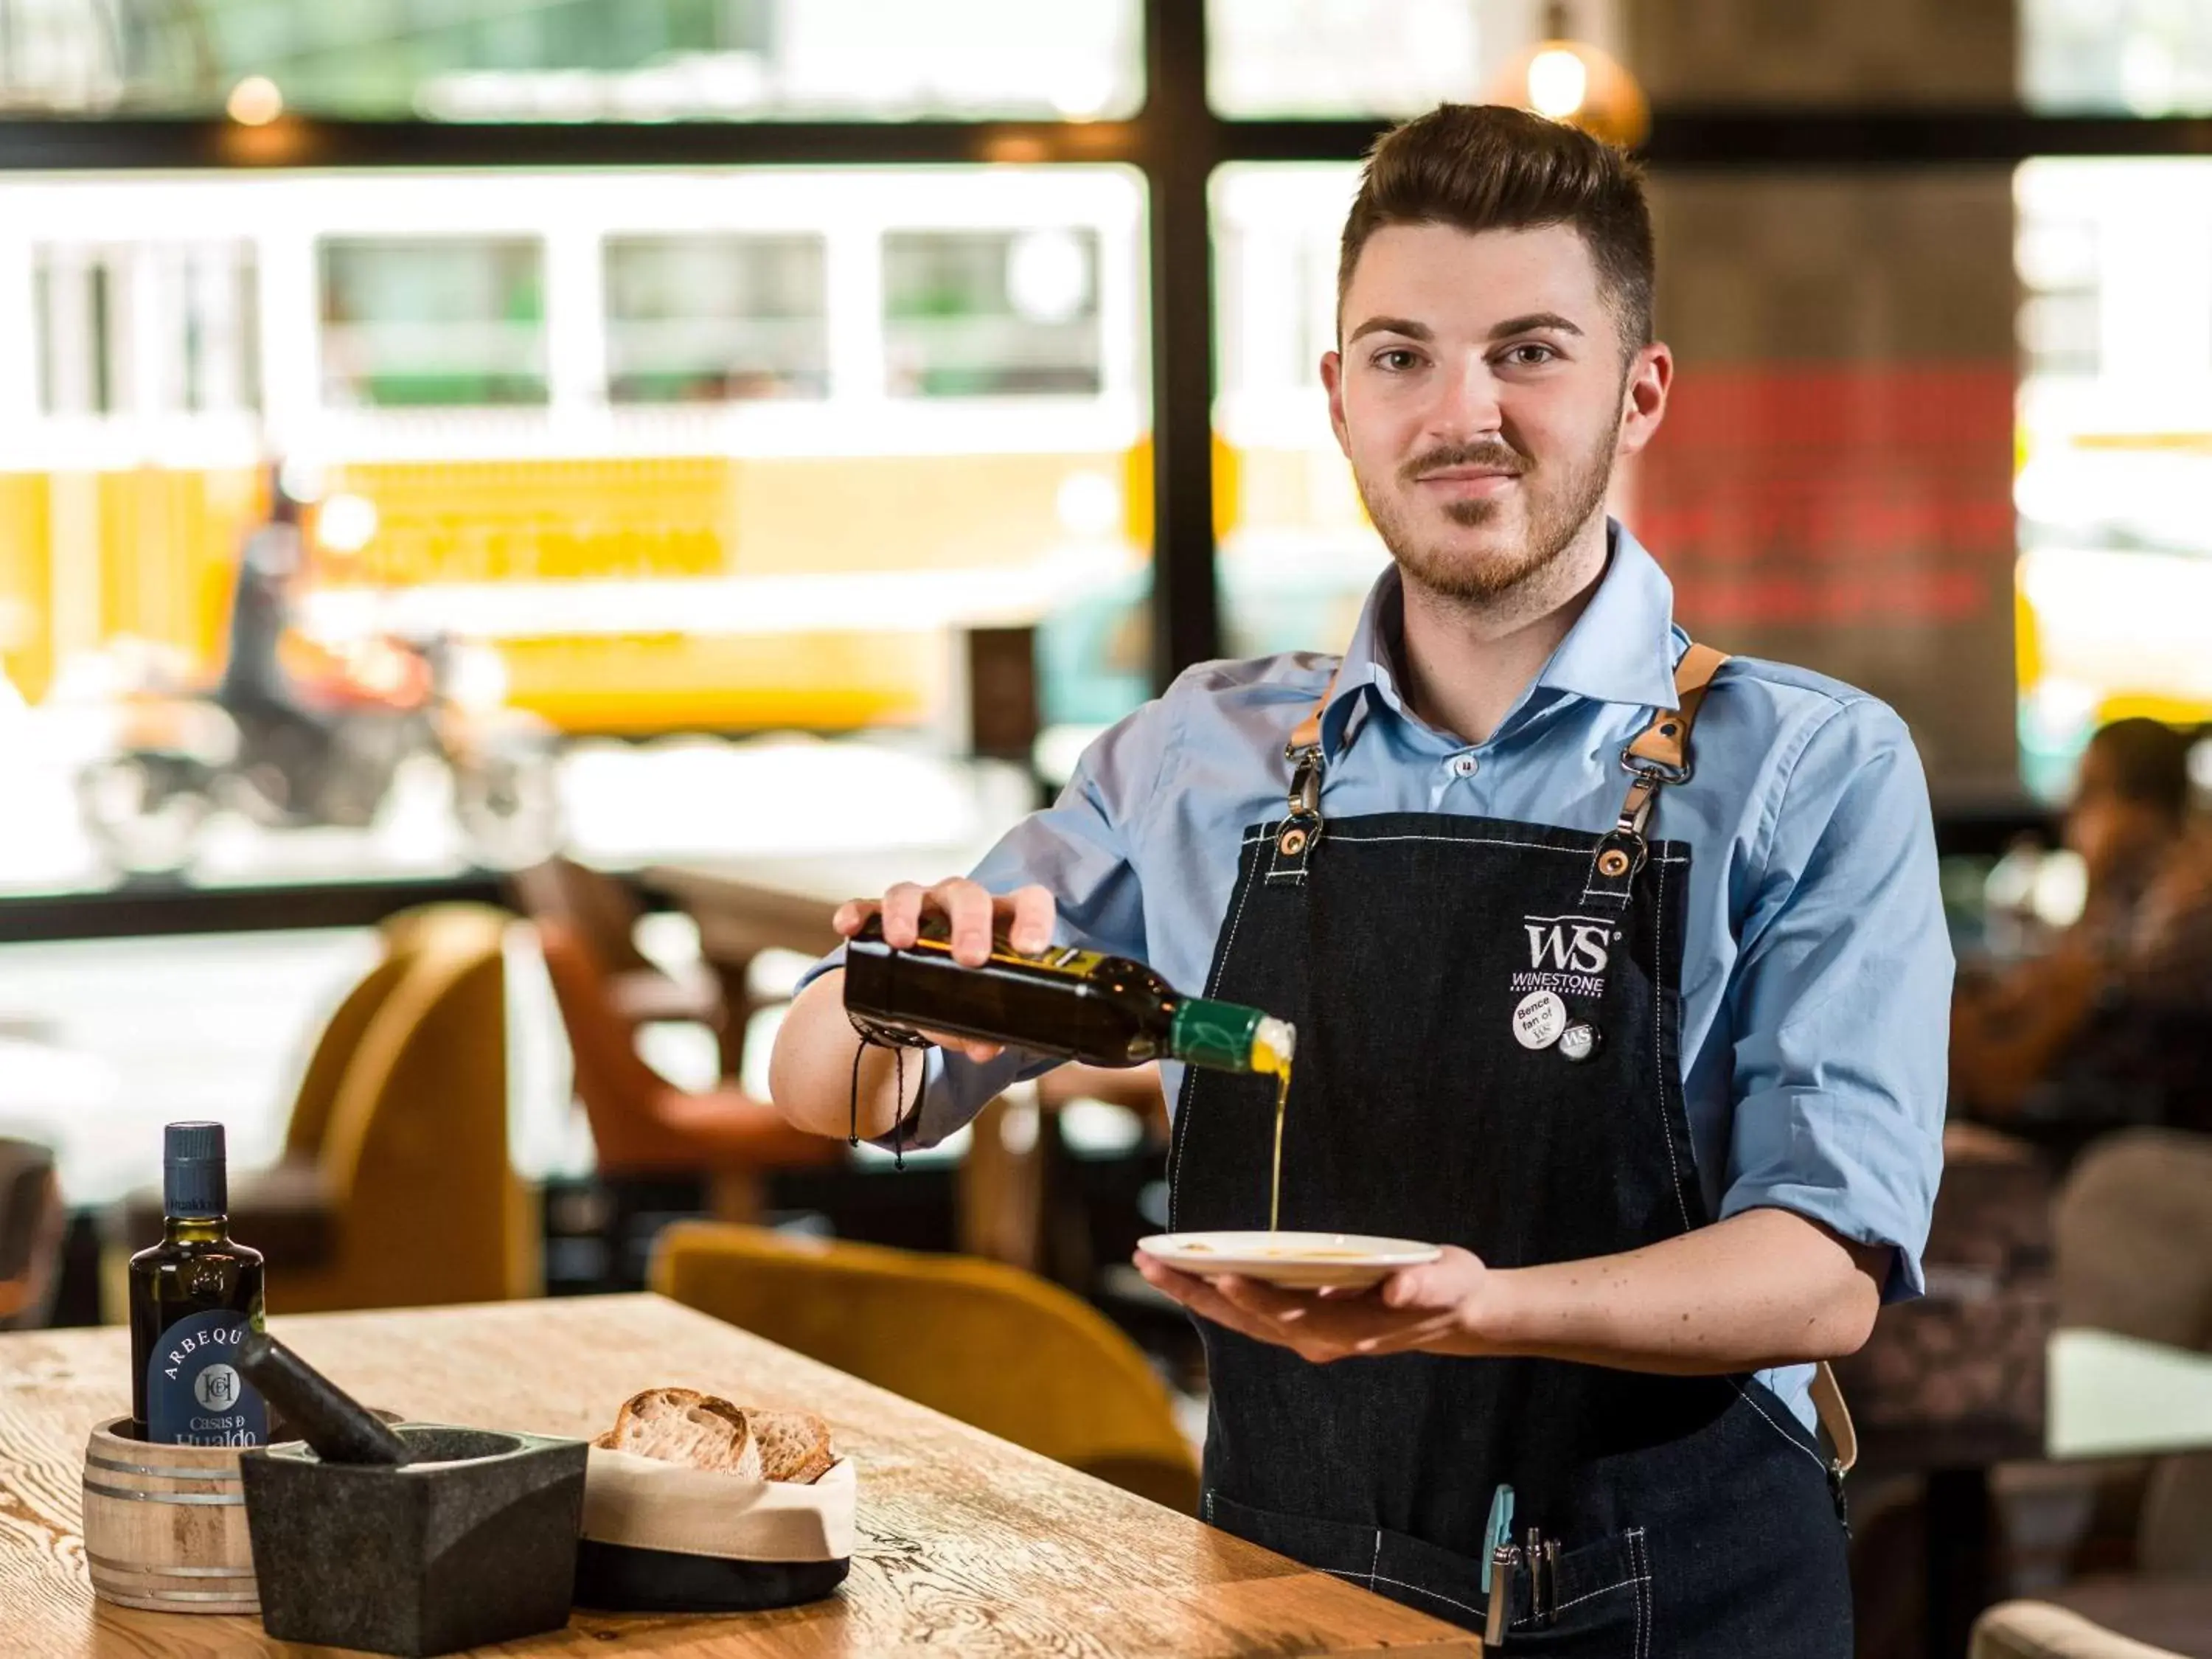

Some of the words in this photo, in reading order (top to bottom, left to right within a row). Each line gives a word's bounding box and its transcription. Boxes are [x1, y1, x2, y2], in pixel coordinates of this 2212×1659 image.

[1512, 972, 1604, 992] WINESTONE
[1517, 996, 1549, 1020] Bence
[1522, 1017, 1540, 1032] fan
[1542, 1006, 1552, 1020] of
[164, 1328, 242, 1380] ARBEQU
[189, 1416, 233, 1430] Casas
